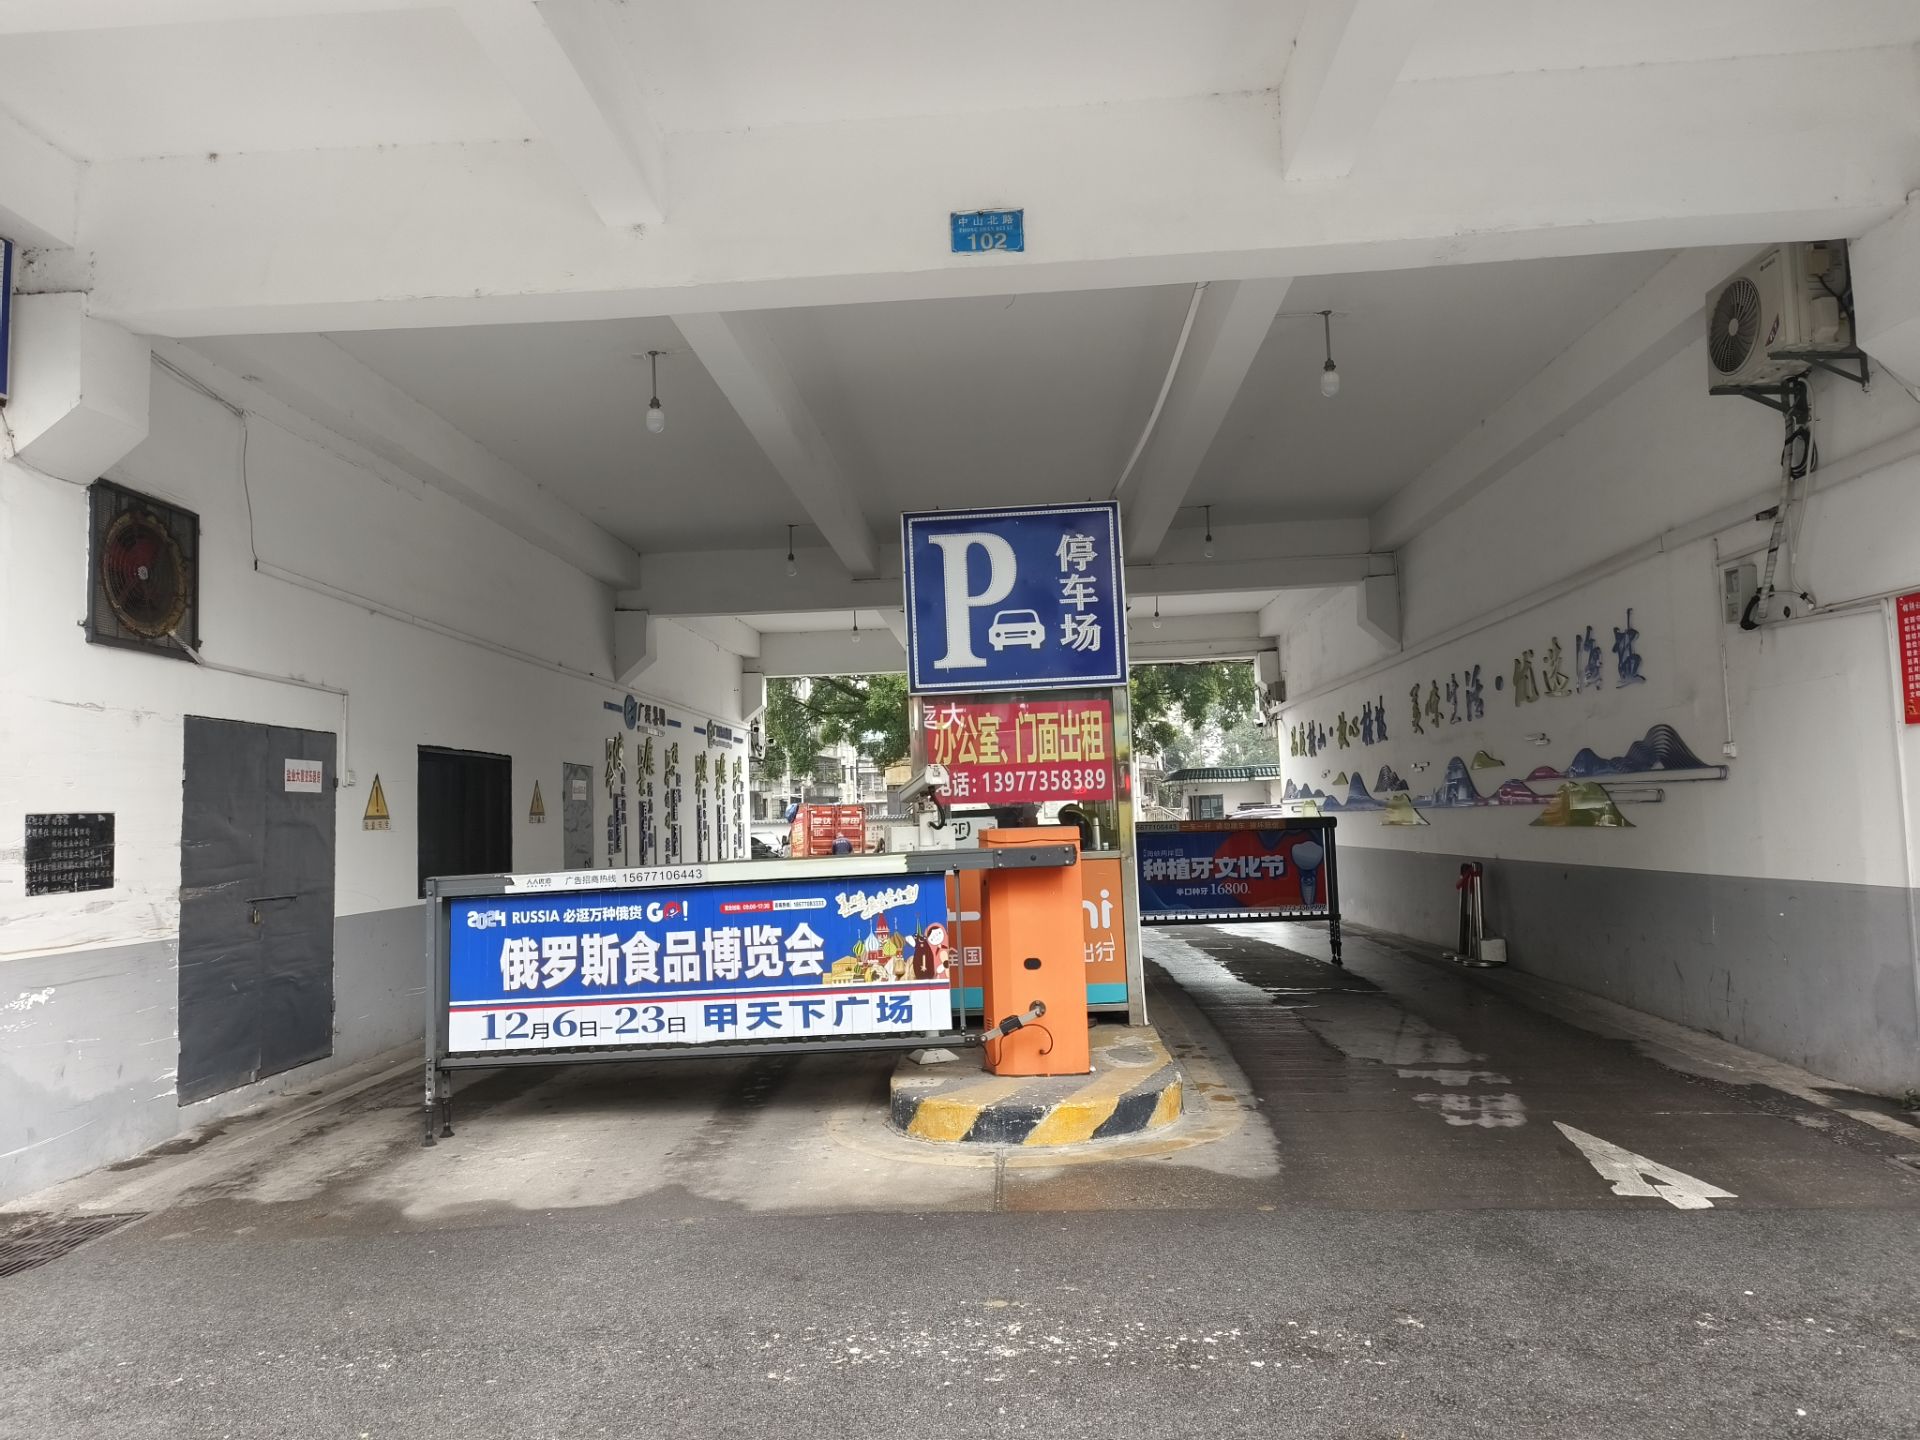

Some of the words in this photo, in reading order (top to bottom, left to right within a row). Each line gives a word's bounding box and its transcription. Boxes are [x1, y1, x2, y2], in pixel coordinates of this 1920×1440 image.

[958, 214, 1014, 226] 中山北路
[967, 232, 1008, 250] 102
[928, 532, 1018, 669] P
[1055, 533, 1102, 652] 停车场
[934, 709, 1106, 766] 办公室、门面出租
[564, 873, 617, 885] 广告招商热线
[622, 868, 703, 884] 15677106443
[1143, 855, 1284, 880] 种植牙文化节
[467, 909, 507, 930] 2024
[511, 909, 561, 924] RUSSIA
[563, 905, 643, 923] 必逛万种俄货
[500, 922, 825, 992] 俄罗斯食品博览会
[480, 1005, 687, 1042] 12月6日-23日
[703, 995, 914, 1034] 甲天下广场
